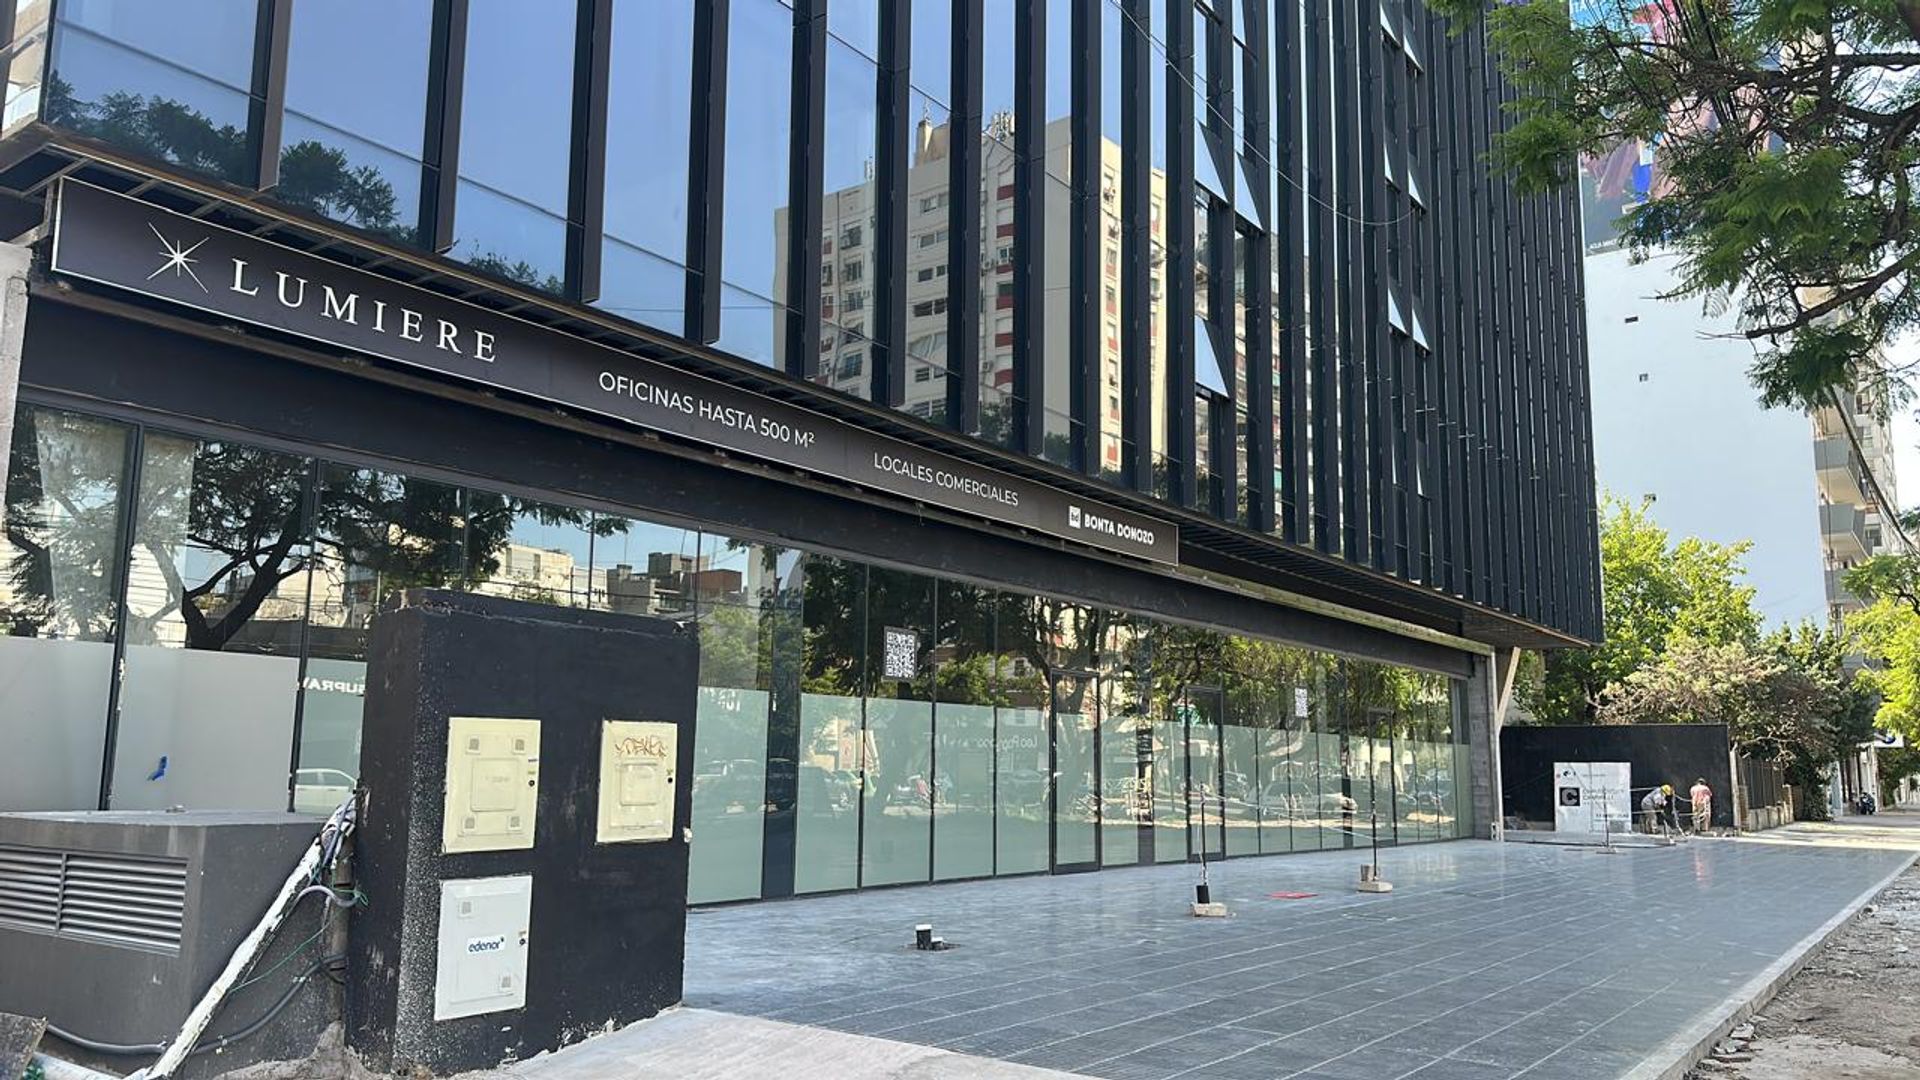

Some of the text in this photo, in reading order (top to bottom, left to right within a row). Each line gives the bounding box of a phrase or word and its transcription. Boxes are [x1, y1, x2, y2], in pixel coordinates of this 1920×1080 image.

[230, 258, 497, 363] LUMIERE
[599, 371, 694, 414] OFICINAS
[699, 399, 757, 434] HASTA
[760, 418, 790, 442] 500
[874, 452, 1019, 507] LOCALES COMERCIALES
[1084, 513, 1155, 546] BONTA DONOZO
[468, 940, 501, 953] edenor
